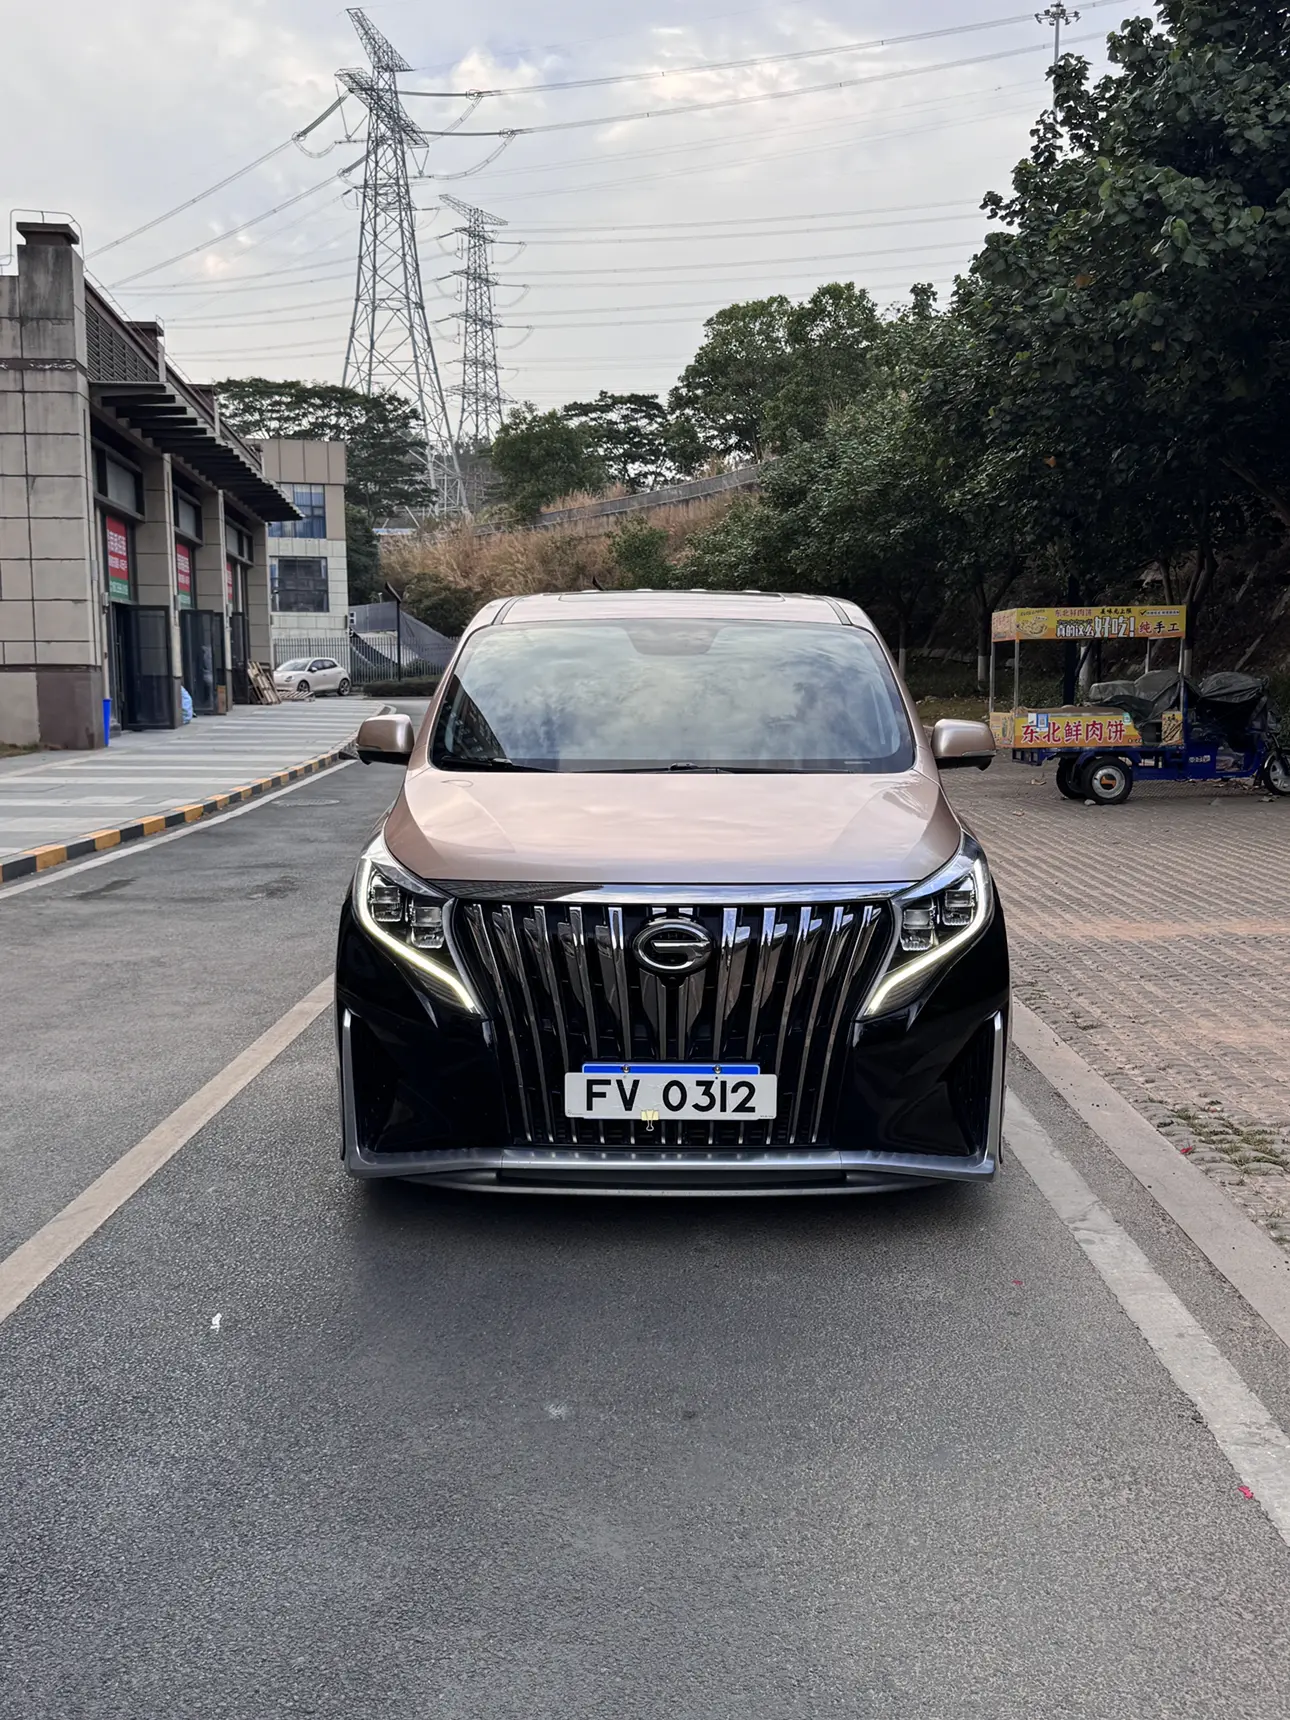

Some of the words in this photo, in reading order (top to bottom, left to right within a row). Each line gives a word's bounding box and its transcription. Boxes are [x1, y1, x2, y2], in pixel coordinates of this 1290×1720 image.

[1139, 620, 1180, 634] 纯手工
[1021, 720, 1126, 744] 东北鲜肉饼
[586, 1079, 640, 1111] FV
[662, 1079, 756, 1113] 0312
